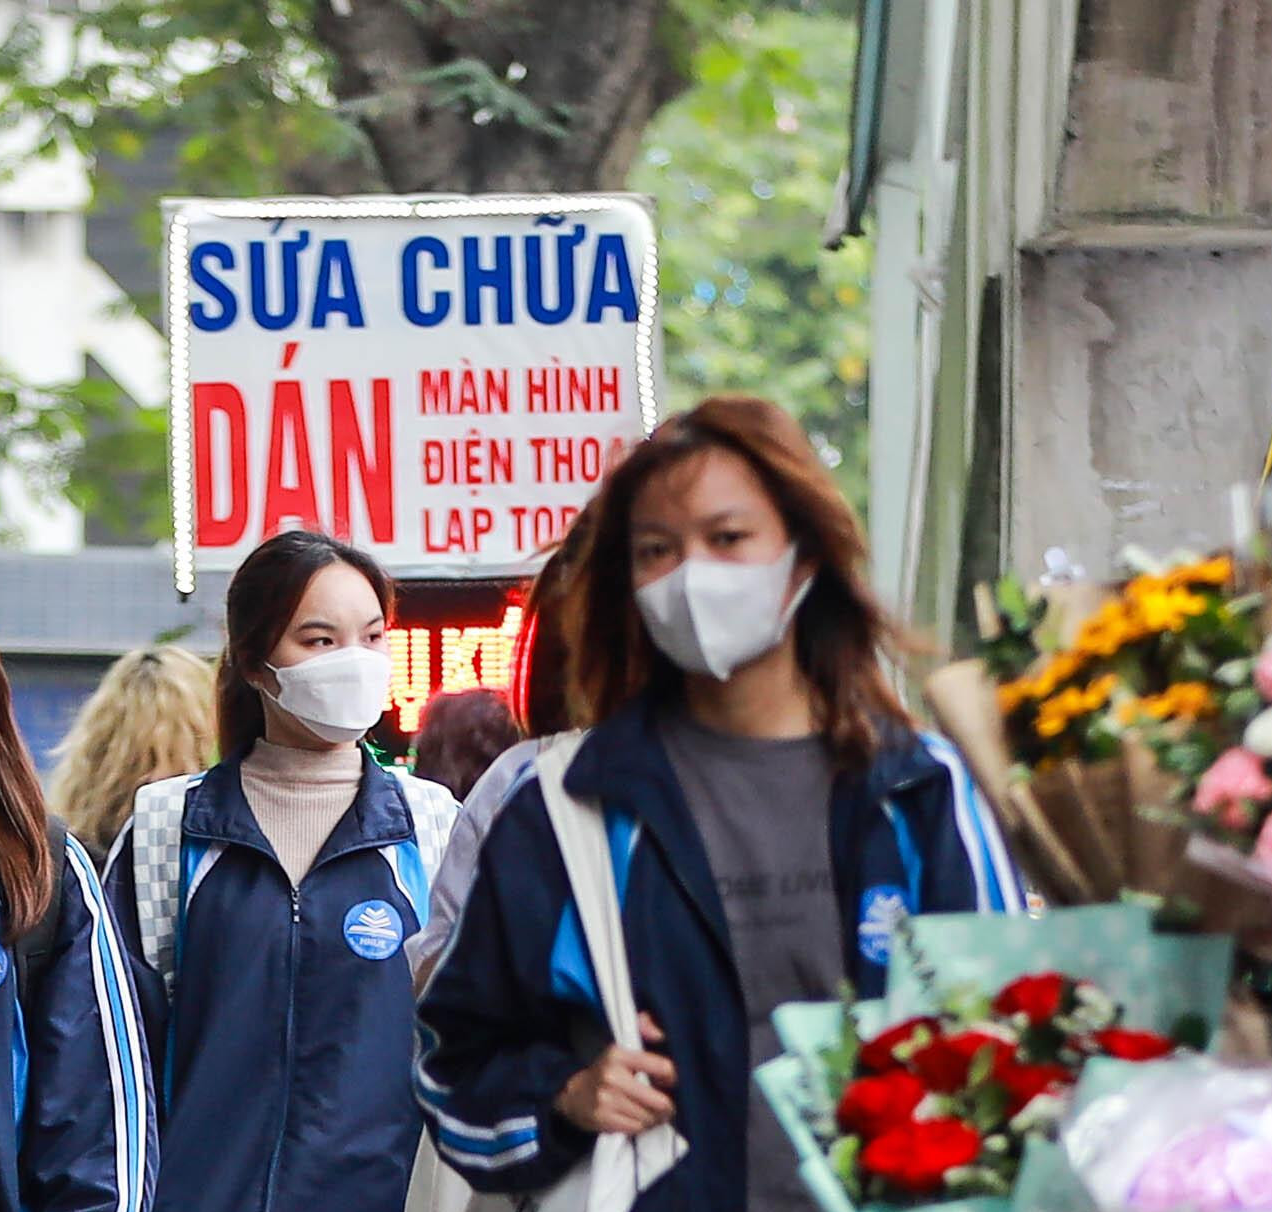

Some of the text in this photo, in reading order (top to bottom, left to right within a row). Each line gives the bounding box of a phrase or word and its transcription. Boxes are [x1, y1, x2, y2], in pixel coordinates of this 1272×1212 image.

[400, 214, 639, 328] CHỮA
[418, 357, 621, 415] MÀN HÌNH
[191, 341, 395, 549] DÁN
[422, 427, 514, 496] ĐIỆN
[424, 506, 495, 554] LAP
